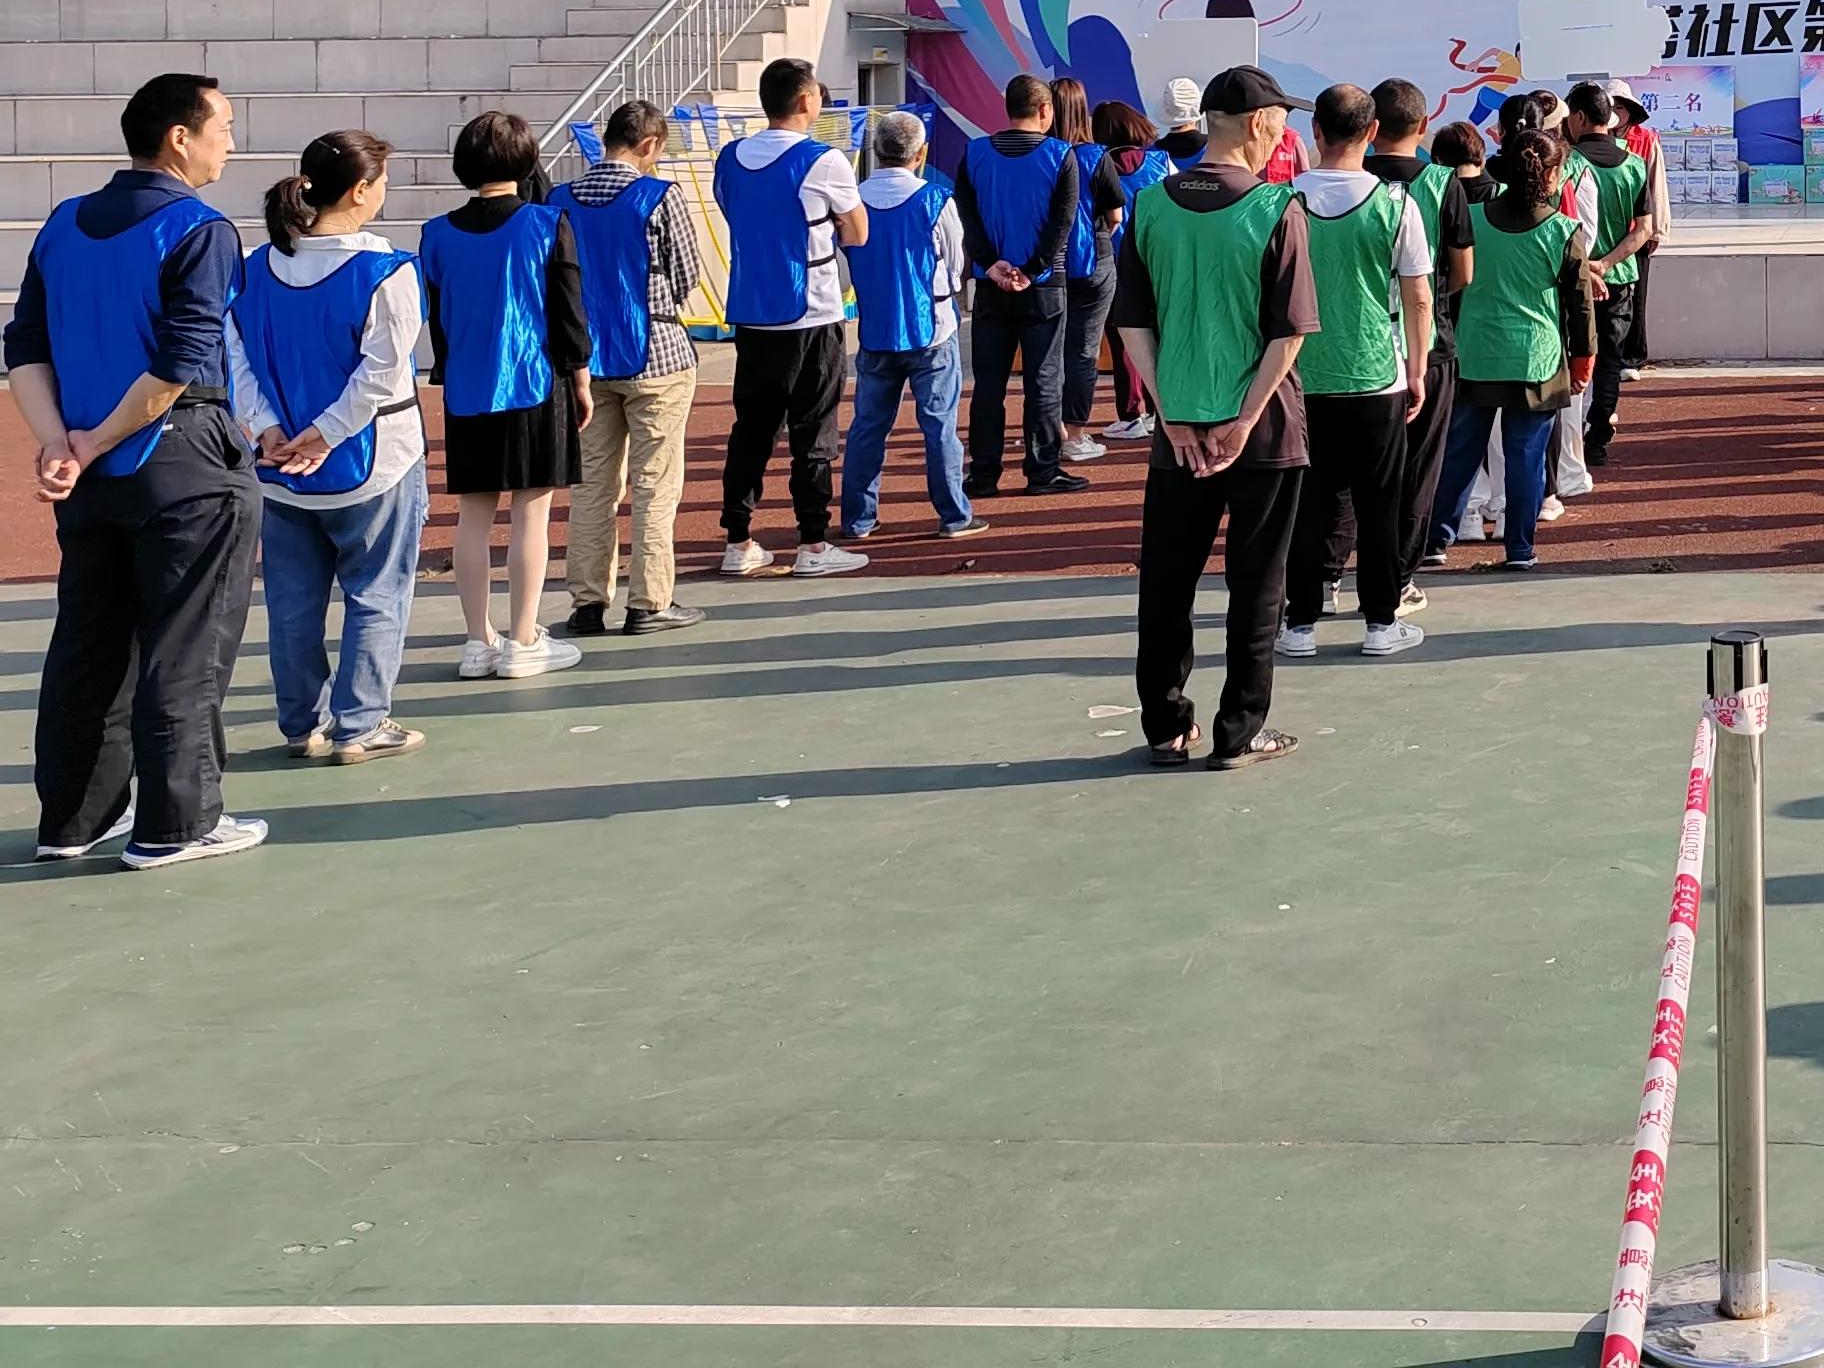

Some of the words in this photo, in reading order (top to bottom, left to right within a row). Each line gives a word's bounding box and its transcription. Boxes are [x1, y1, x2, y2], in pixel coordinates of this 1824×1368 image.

[1640, 91, 1703, 113] 第二名
[1179, 179, 1221, 192] adidas
[1687, 772, 1704, 805] SAFE
[1683, 818, 1700, 862] CAUTION
[1678, 882, 1697, 922] SAFE
[1674, 935, 1693, 991] CAUTION
[1626, 1162, 1657, 1212] 安全
[1613, 1247, 1650, 1315] 注意
